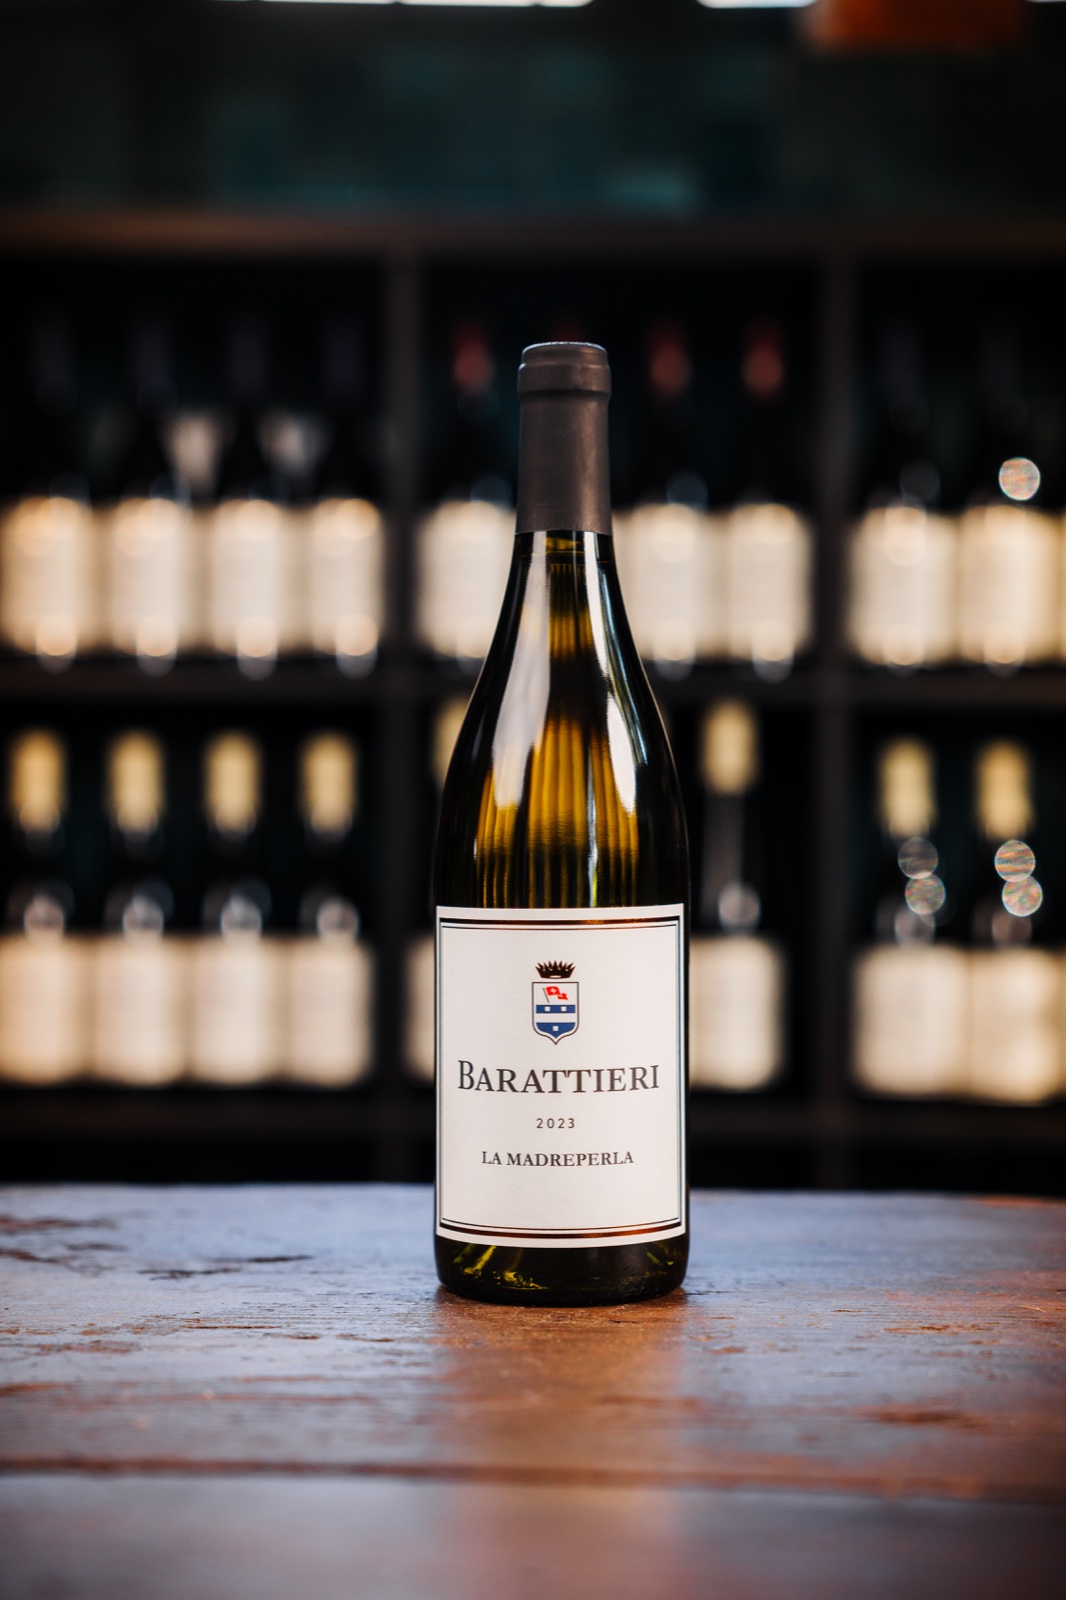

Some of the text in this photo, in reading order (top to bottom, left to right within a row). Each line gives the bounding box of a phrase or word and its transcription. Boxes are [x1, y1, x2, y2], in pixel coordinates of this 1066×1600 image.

[457, 1060, 660, 1094] BARATTIERI
[535, 1117, 576, 1129] 2023
[481, 1151, 634, 1167] LA MADREPERLA
